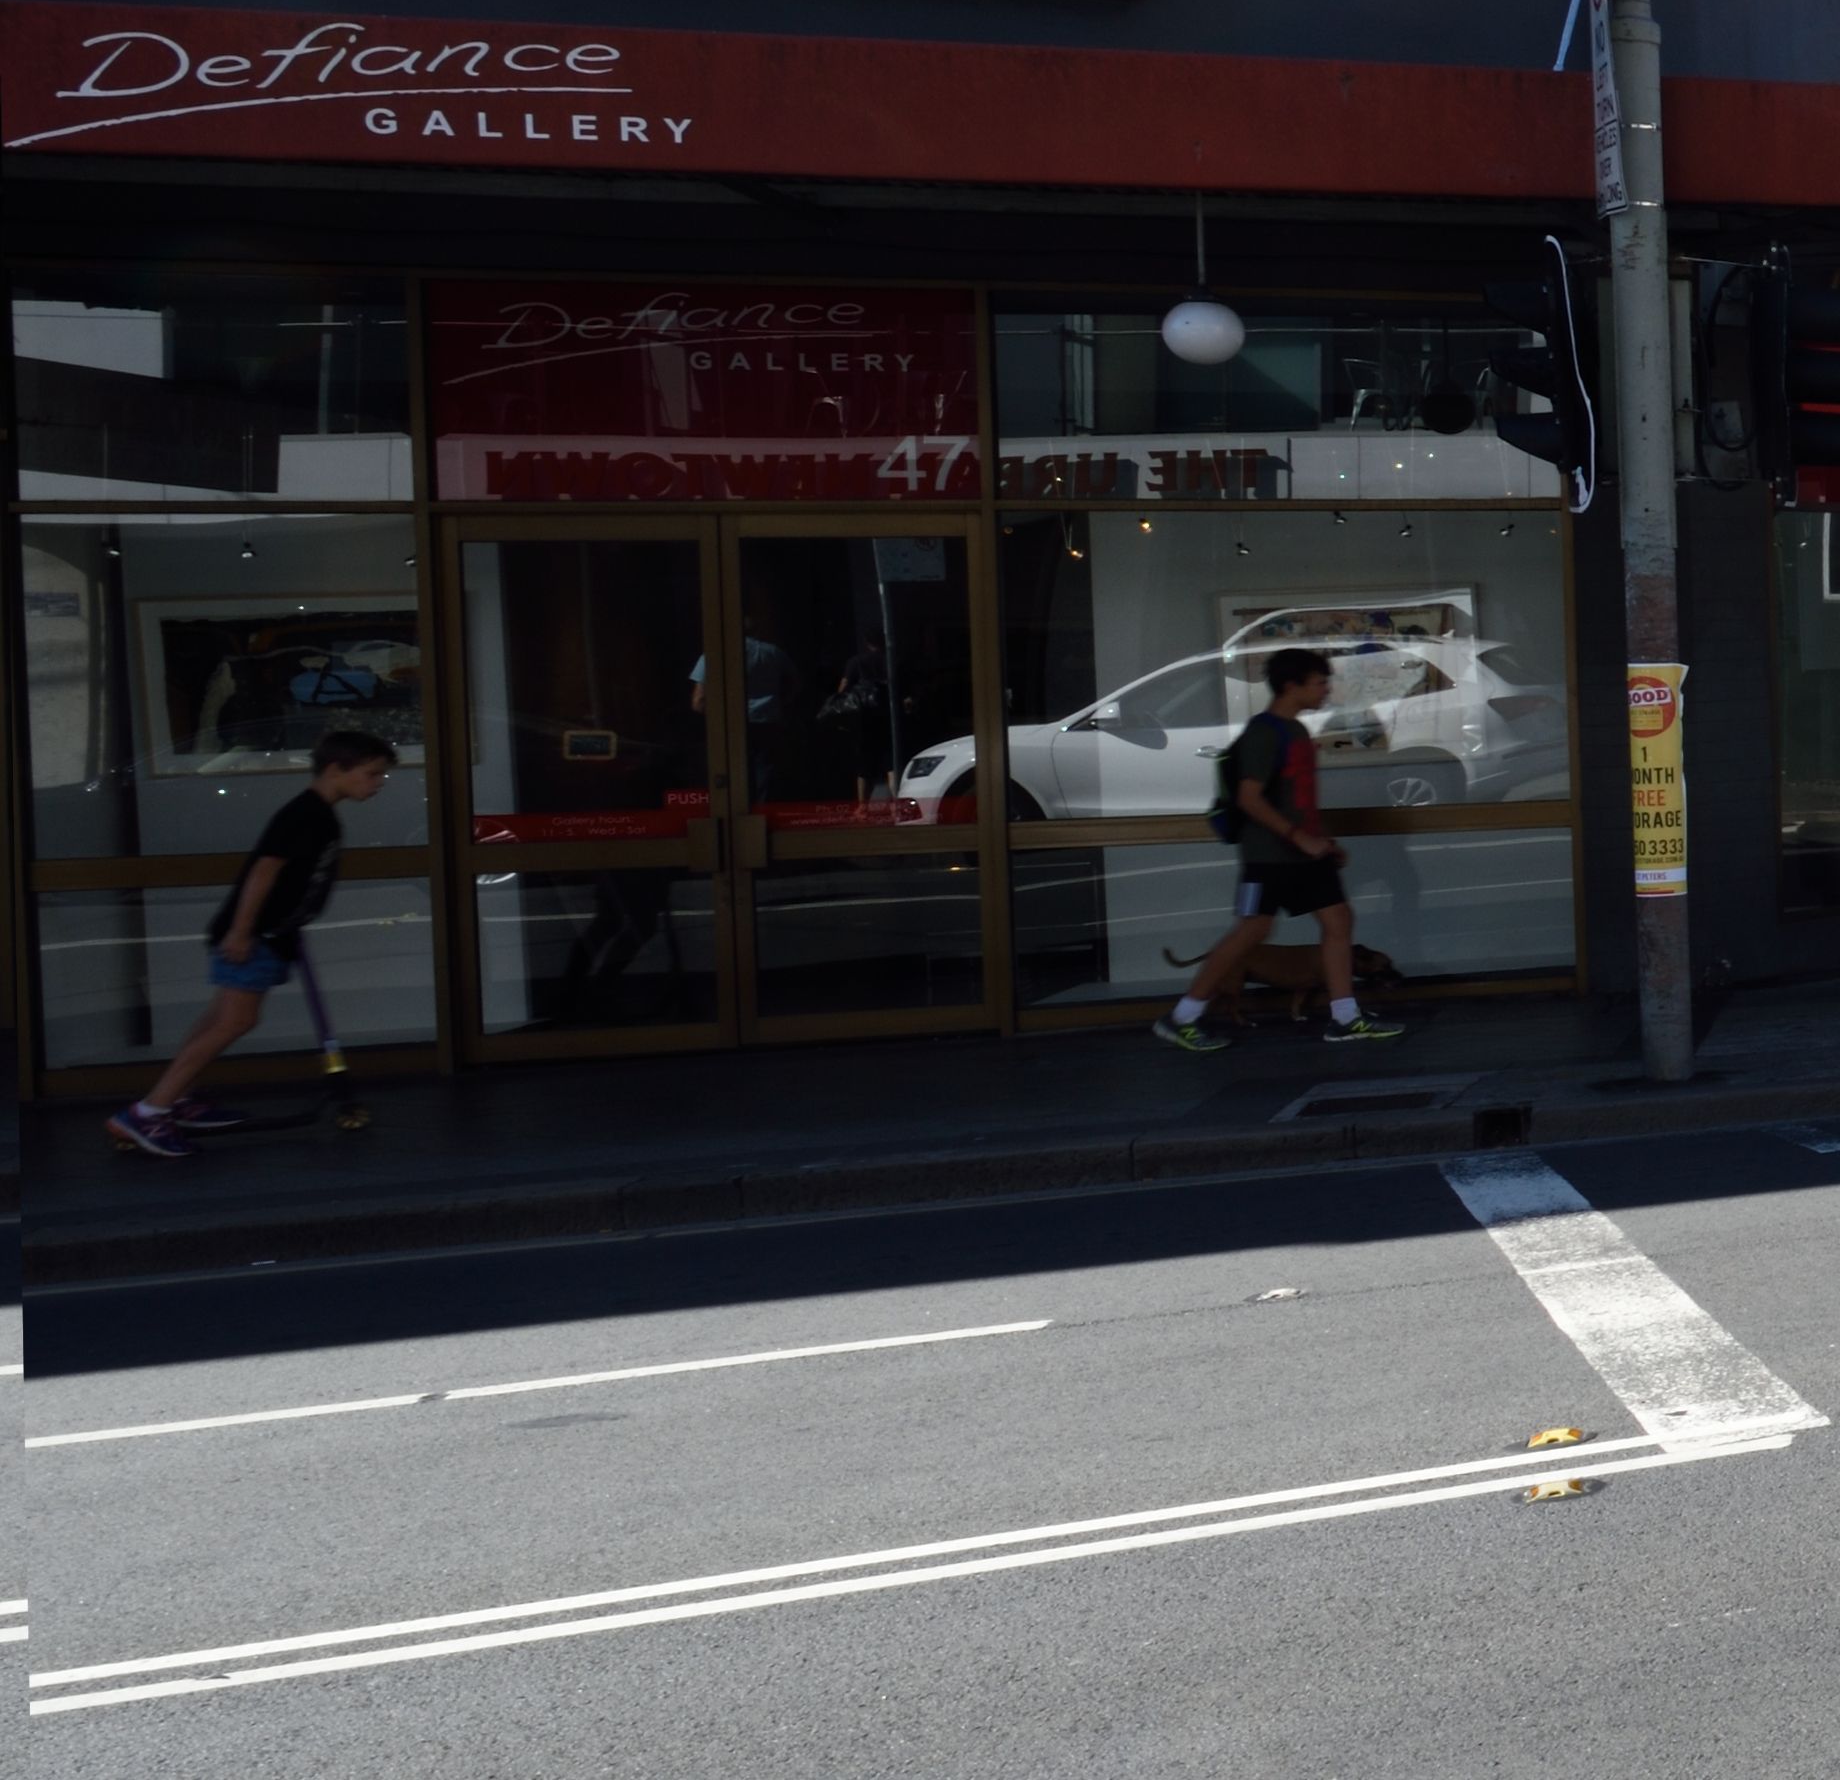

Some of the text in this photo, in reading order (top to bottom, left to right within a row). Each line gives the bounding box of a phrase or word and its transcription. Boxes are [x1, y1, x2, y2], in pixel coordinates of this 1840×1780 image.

[55, 22, 622, 98] Defiance
[363, 107, 694, 145] GALLERY
[481, 292, 866, 350] Defiance
[688, 351, 917, 373] GALLERY
[876, 435, 970, 492] 47
[1641, 746, 1648, 763] 1
[1633, 767, 1674, 785] ONTH
[667, 793, 709, 804] PUSH
[588, 826, 616, 836] Wed
[626, 825, 648, 836] Sat
